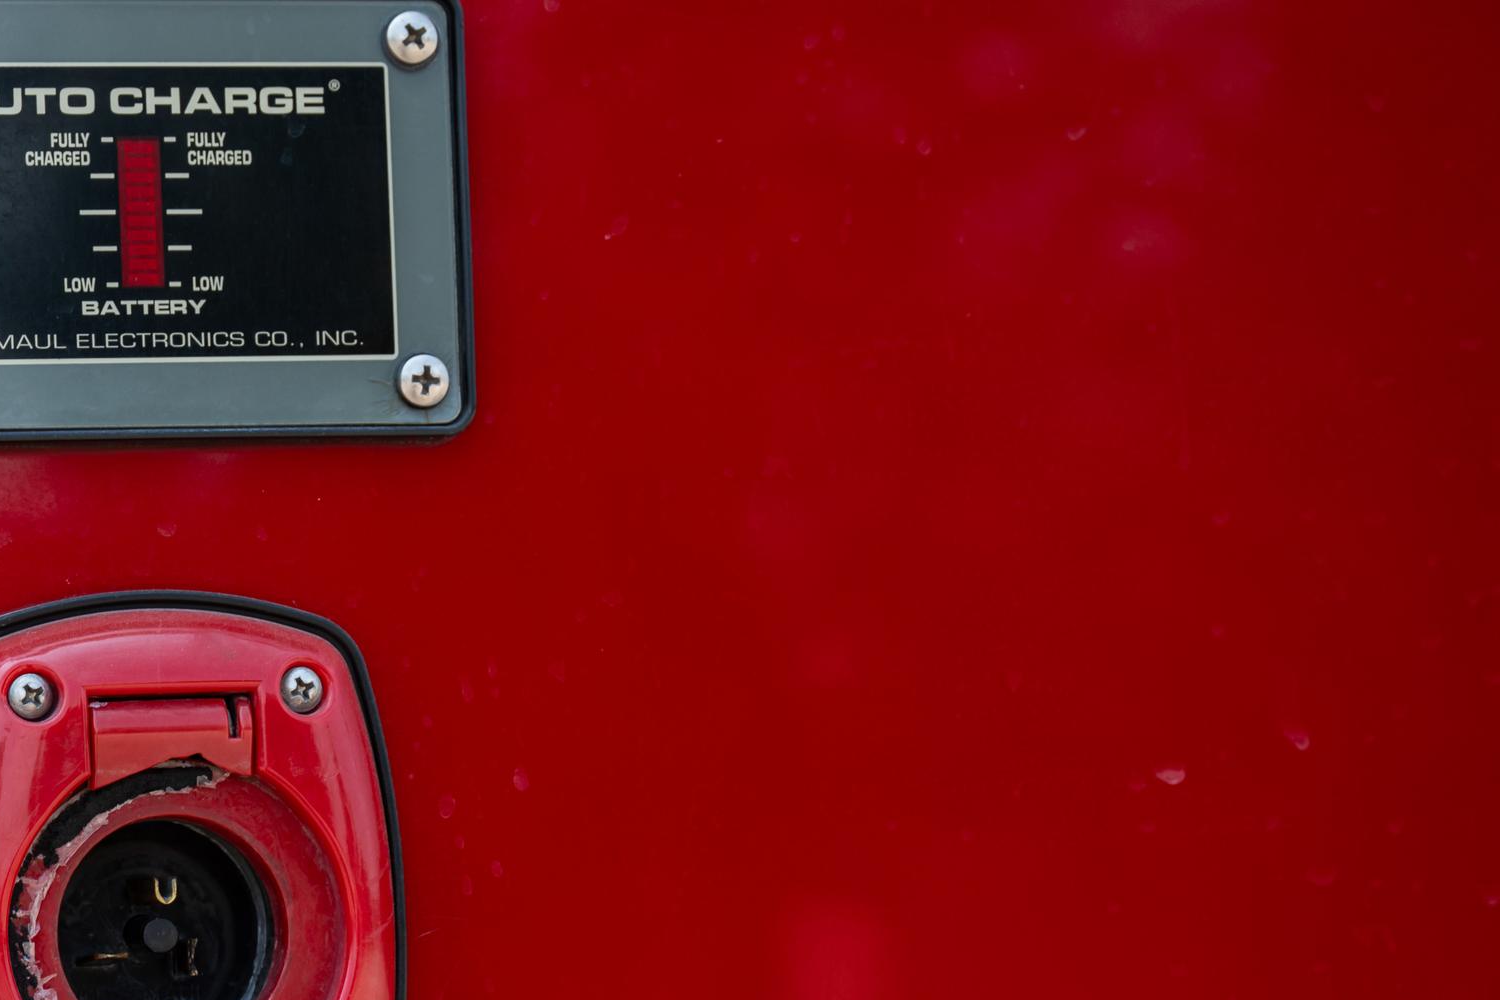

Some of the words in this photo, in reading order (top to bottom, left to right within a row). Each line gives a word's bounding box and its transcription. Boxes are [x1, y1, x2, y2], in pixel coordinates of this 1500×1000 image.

[50, 132, 90, 148] FULLY
[186, 131, 226, 148] FULLY
[24, 150, 91, 167] CHARGED
[187, 149, 253, 166] CHARGED
[63, 277, 96, 293] LOW
[192, 275, 224, 292] LOW
[81, 299, 206, 316] BATTERY
[76, 331, 245, 349] ELECTRONICS
[254, 330, 304, 349] CO.,
[316, 330, 364, 347] INC.
